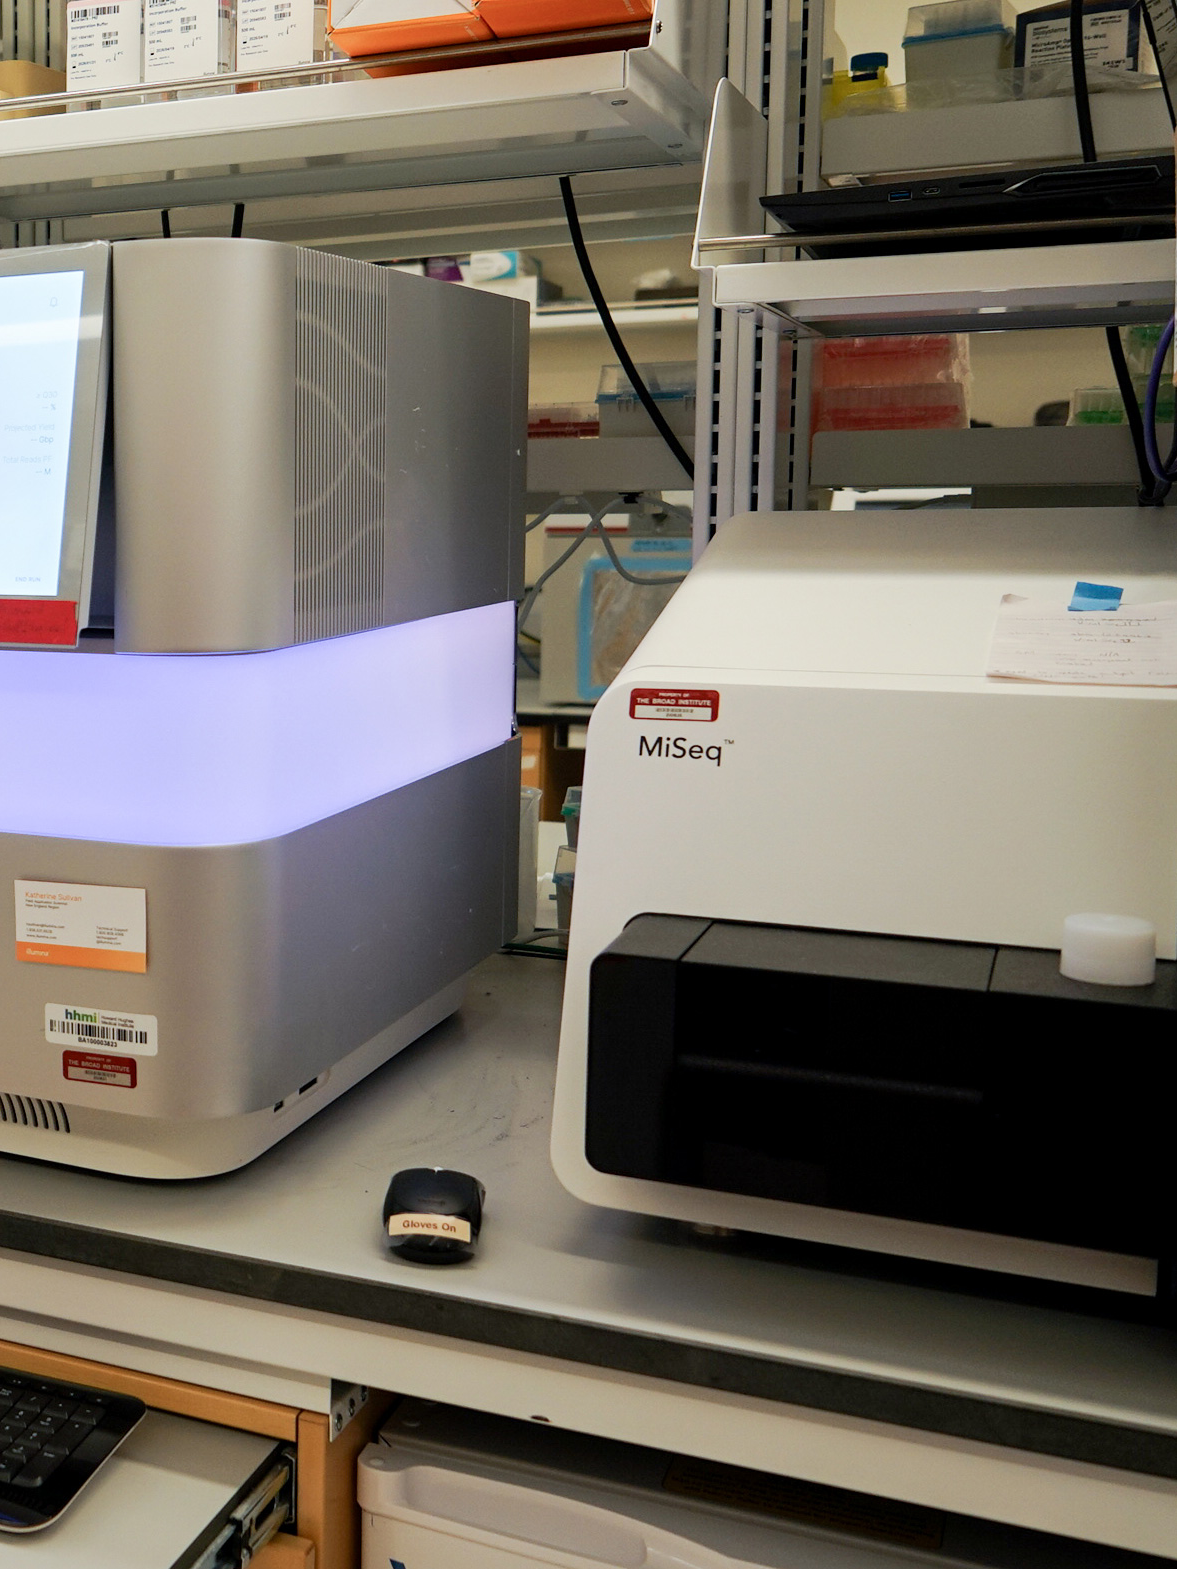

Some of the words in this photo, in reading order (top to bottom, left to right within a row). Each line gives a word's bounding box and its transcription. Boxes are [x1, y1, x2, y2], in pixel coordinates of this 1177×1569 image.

[25, 892, 56, 900] Katherine
[58, 894, 82, 902] Sullivan
[65, 1008, 97, 1023] hhmi
[103, 1064, 130, 1072] INSTITUTE
[402, 1220, 438, 1230] Gloves
[441, 1223, 456, 1232] On
